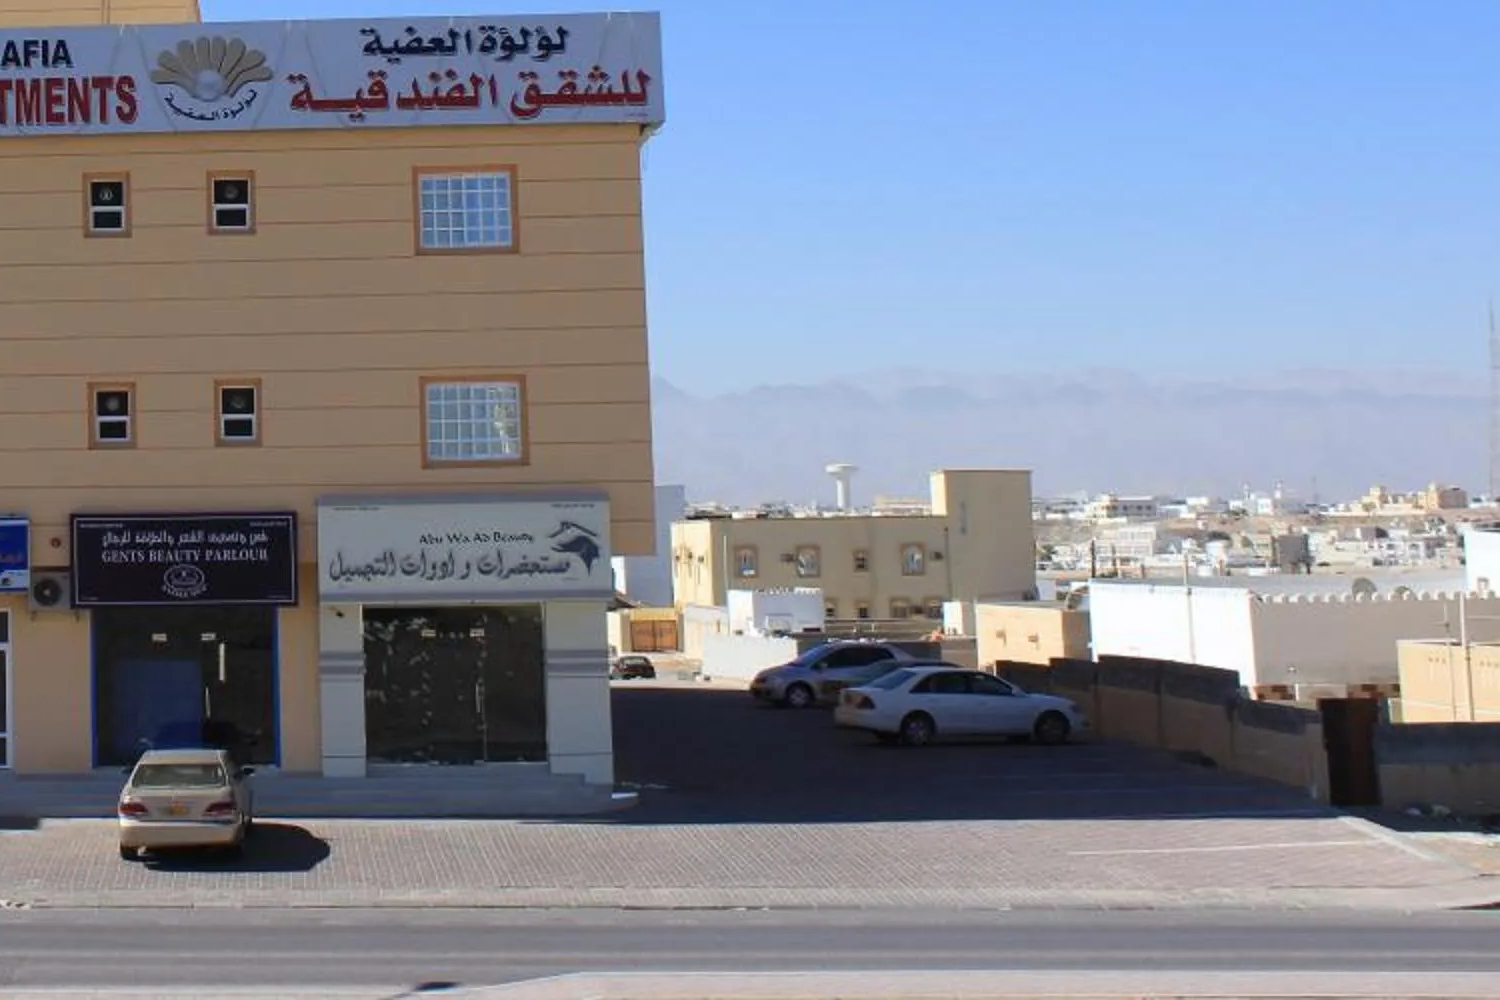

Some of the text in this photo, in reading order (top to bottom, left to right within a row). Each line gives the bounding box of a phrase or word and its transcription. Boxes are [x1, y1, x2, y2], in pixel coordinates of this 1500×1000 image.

[1, 39, 74, 69] AFIA
[286, 65, 651, 122] للشقق الفندقية
[102, 547, 268, 563] GENTS BEAUTY PARLOUR
